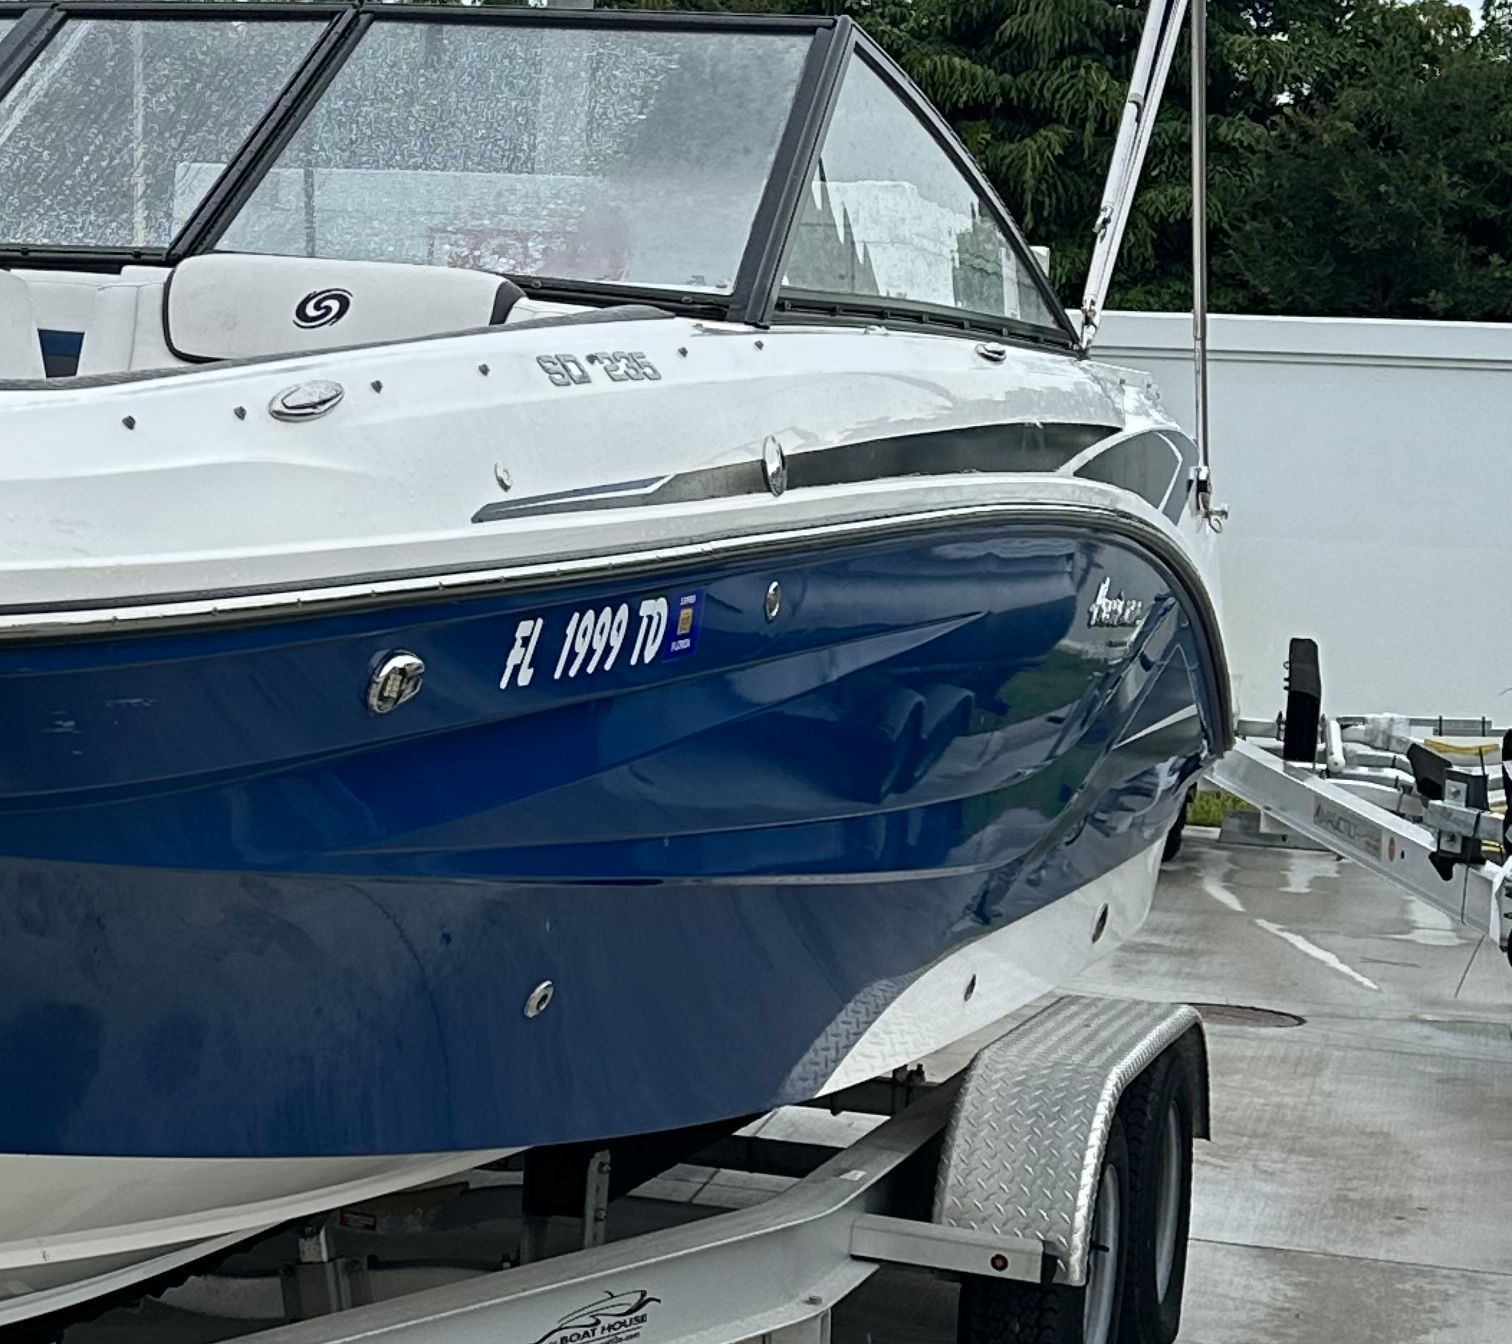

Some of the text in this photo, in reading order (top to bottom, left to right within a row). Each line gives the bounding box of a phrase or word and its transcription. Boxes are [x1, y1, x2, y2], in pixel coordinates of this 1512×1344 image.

[535, 353, 592, 387] SD
[499, 617, 544, 690] FL
[553, 602, 629, 680] 1999
[560, 1328, 596, 1344] BOAT
